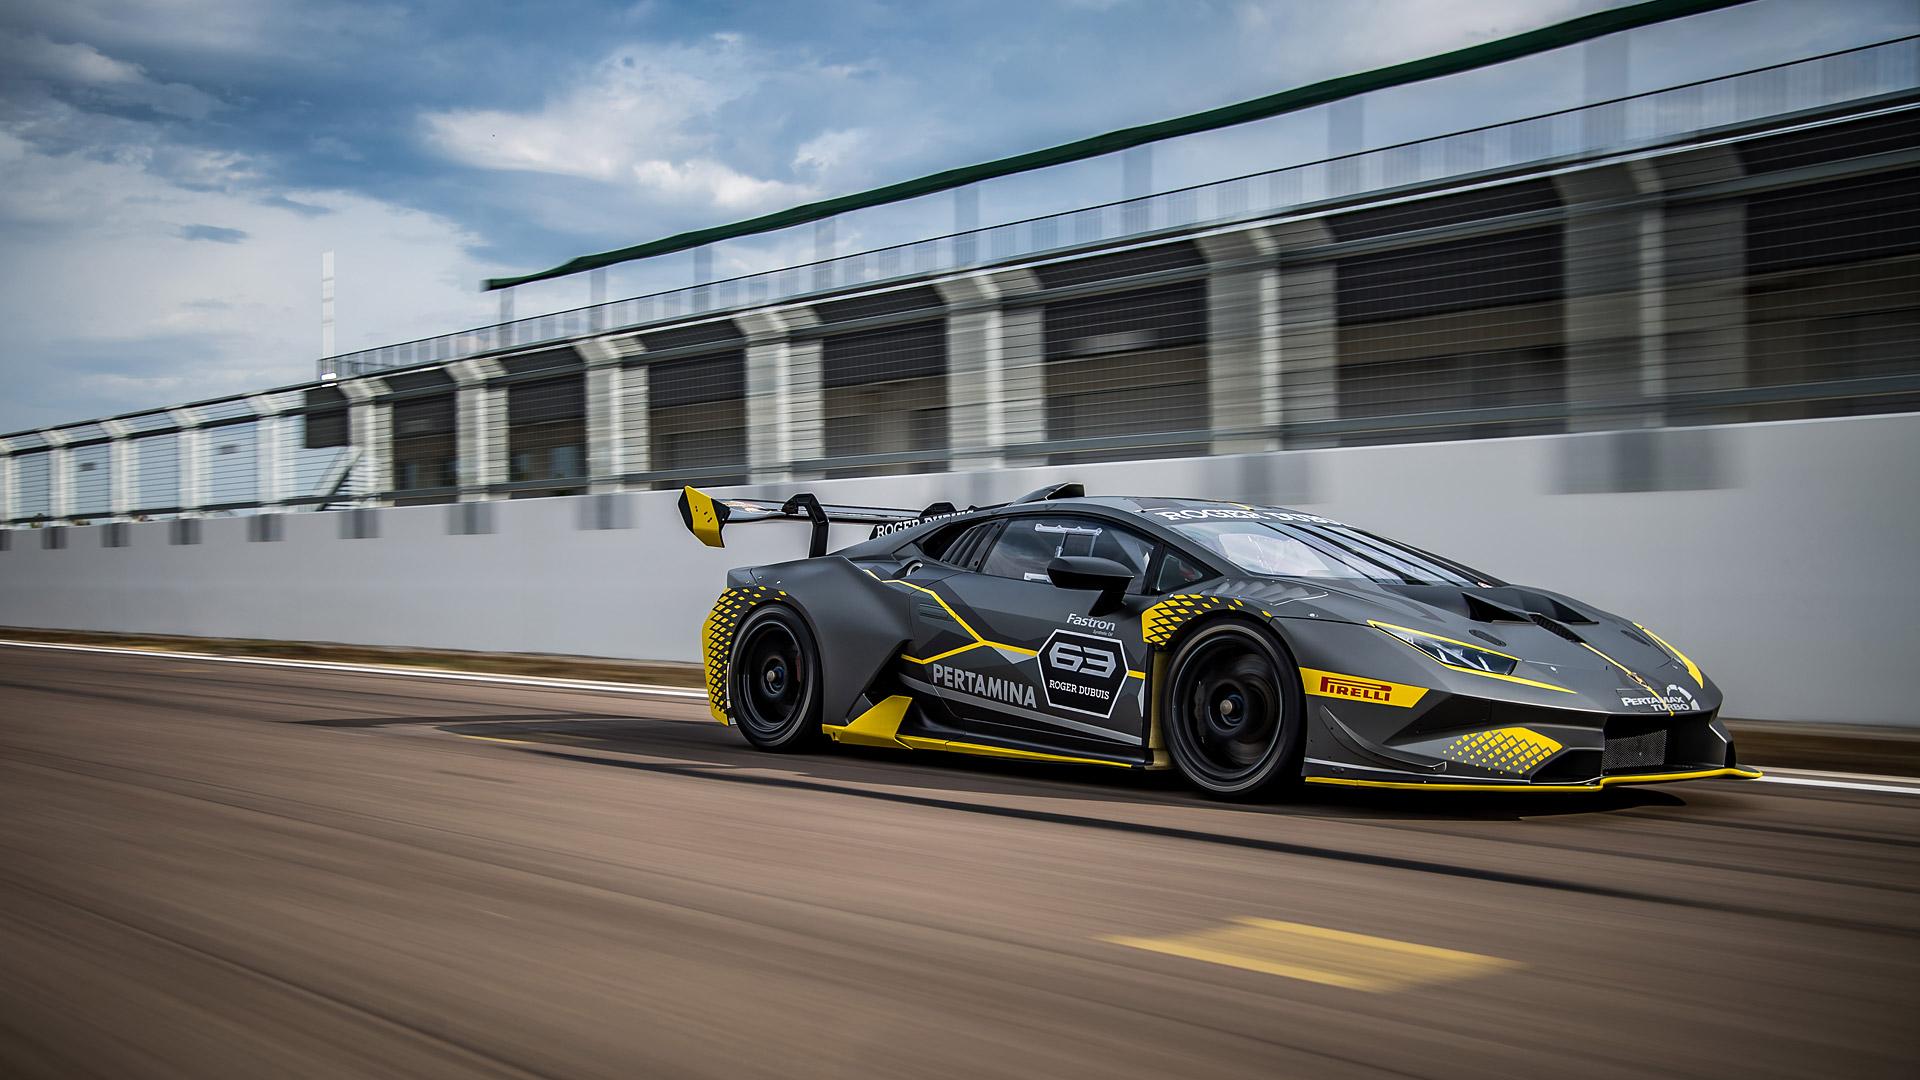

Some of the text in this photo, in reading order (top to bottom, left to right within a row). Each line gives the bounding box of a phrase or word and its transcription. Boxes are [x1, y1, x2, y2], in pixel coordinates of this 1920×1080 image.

[1066, 613, 1116, 631] Fastron
[1049, 642, 1116, 678] 63
[933, 663, 1037, 709] PERTAMINA
[1049, 680, 1110, 700] ROGER DUBUIS
[1320, 676, 1392, 702] PIRELLI
[1621, 696, 1685, 707] PERTAMAX
[1651, 703, 1690, 712] TURBO
